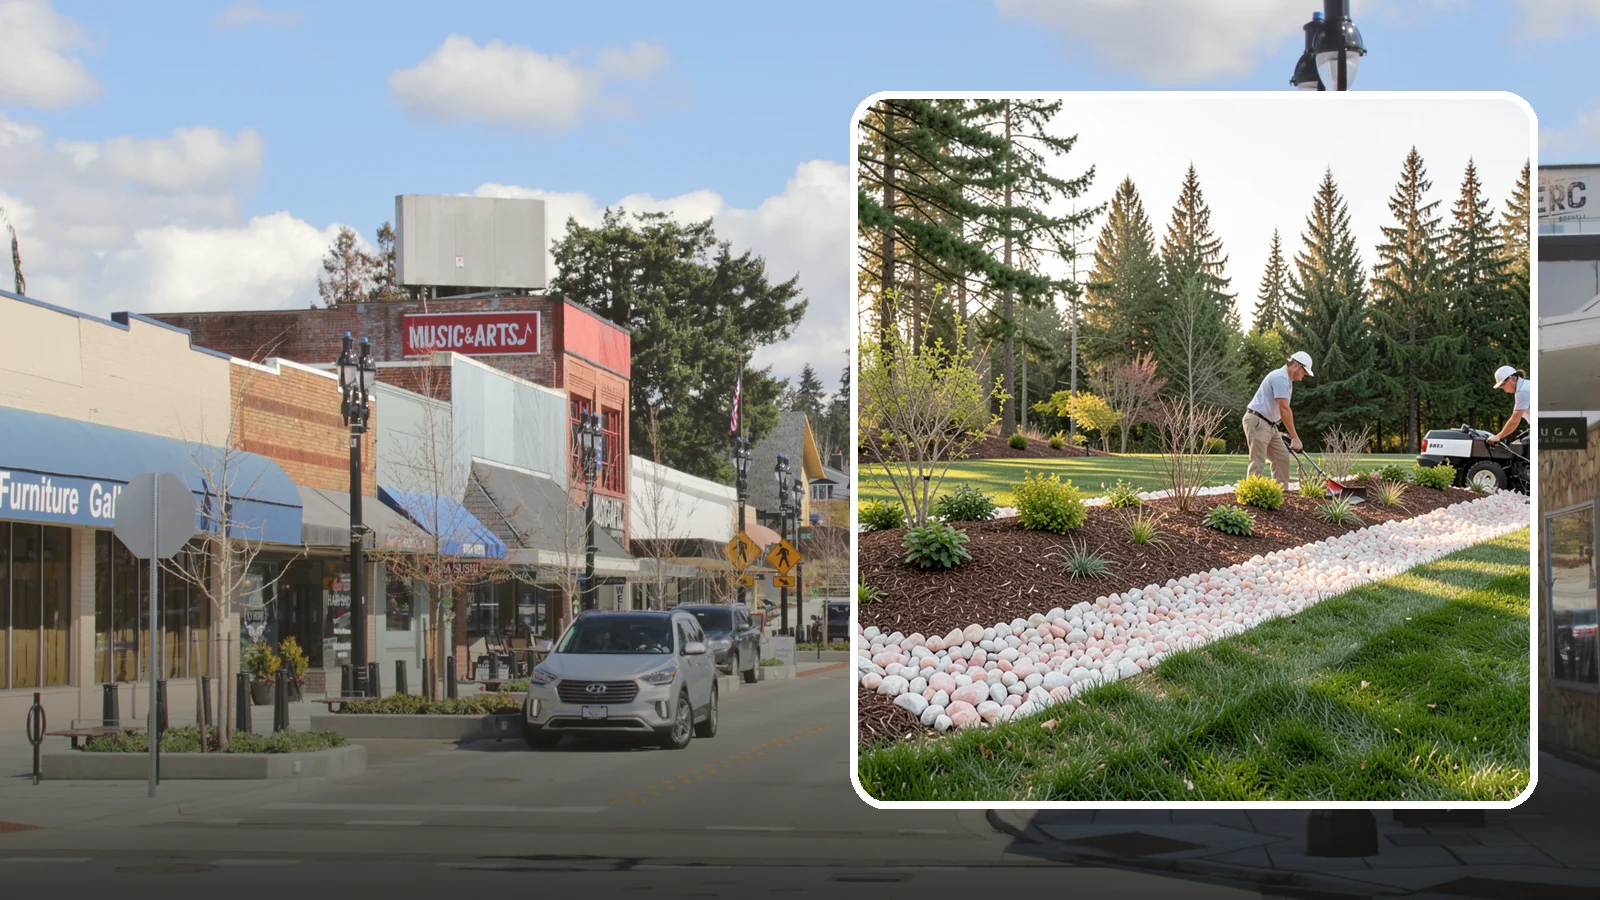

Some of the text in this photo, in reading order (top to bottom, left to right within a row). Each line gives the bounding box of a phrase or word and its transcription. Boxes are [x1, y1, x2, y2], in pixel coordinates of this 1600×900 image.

[409, 323, 519, 348] MUSIC&ARTS
[1541, 428, 1577, 436] UGA
[0, 471, 122, 519] Furniture Gal
[453, 563, 479, 574] SUSHI
